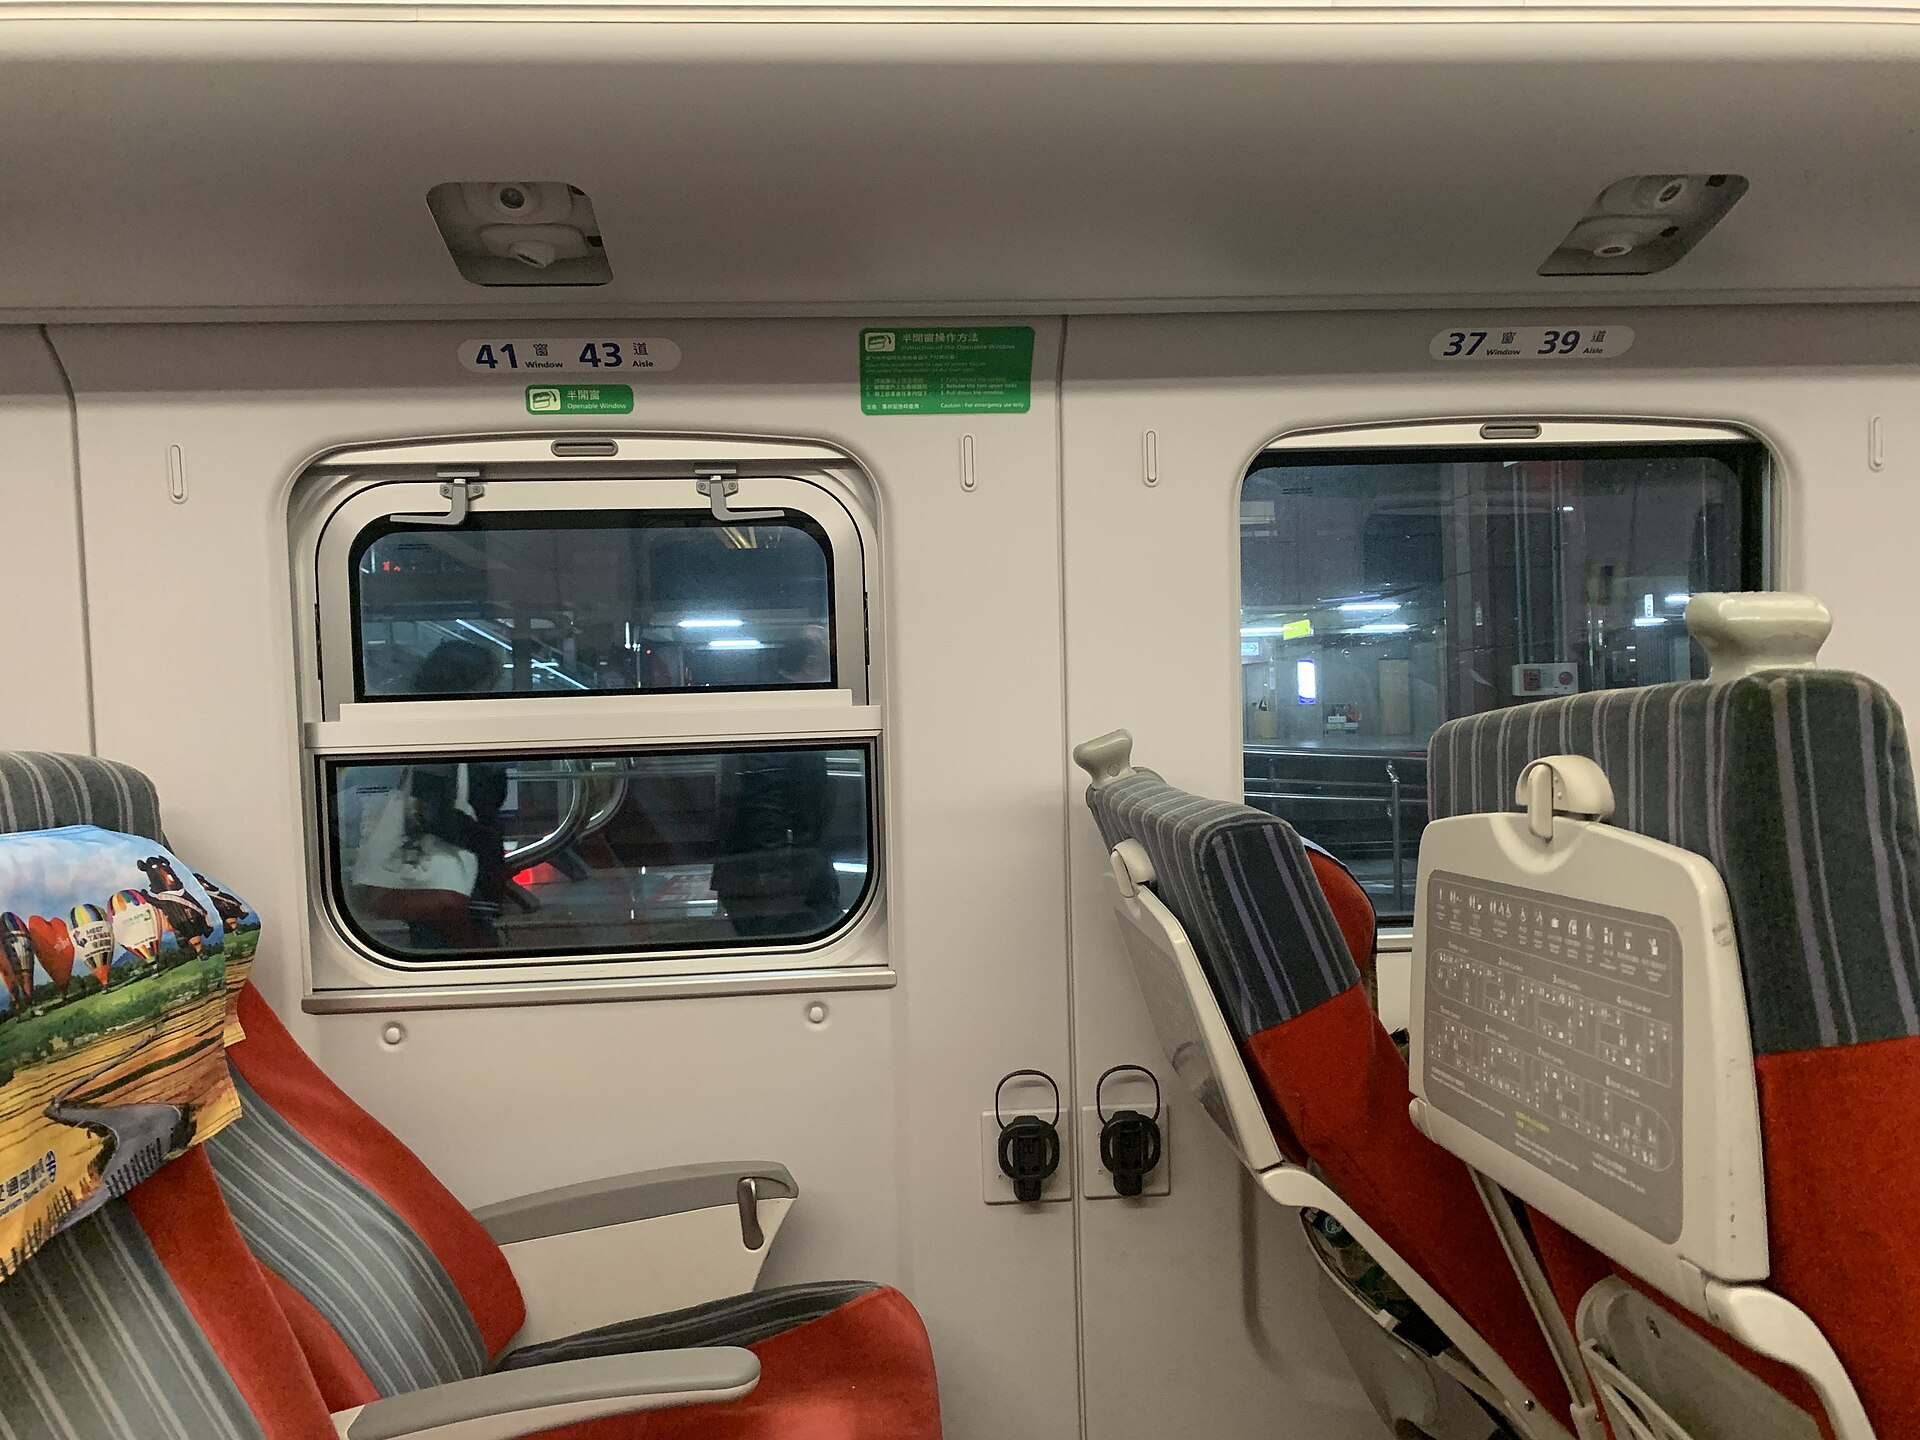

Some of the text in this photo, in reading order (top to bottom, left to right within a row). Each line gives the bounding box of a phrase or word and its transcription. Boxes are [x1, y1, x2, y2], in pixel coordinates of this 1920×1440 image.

[1537, 330, 1581, 355] 39
[1590, 330, 1607, 343] 道
[533, 343, 548, 357] 窗
[633, 342, 649, 356] 道
[1443, 332, 1488, 357] 37
[475, 343, 519, 369] 41
[579, 342, 623, 368] 43
[1486, 348, 1522, 356] Window
[525, 360, 564, 369] Window
[632, 360, 654, 368] Aisle
[567, 389, 600, 400] 半開窗
[567, 402, 627, 411] Openable Window
